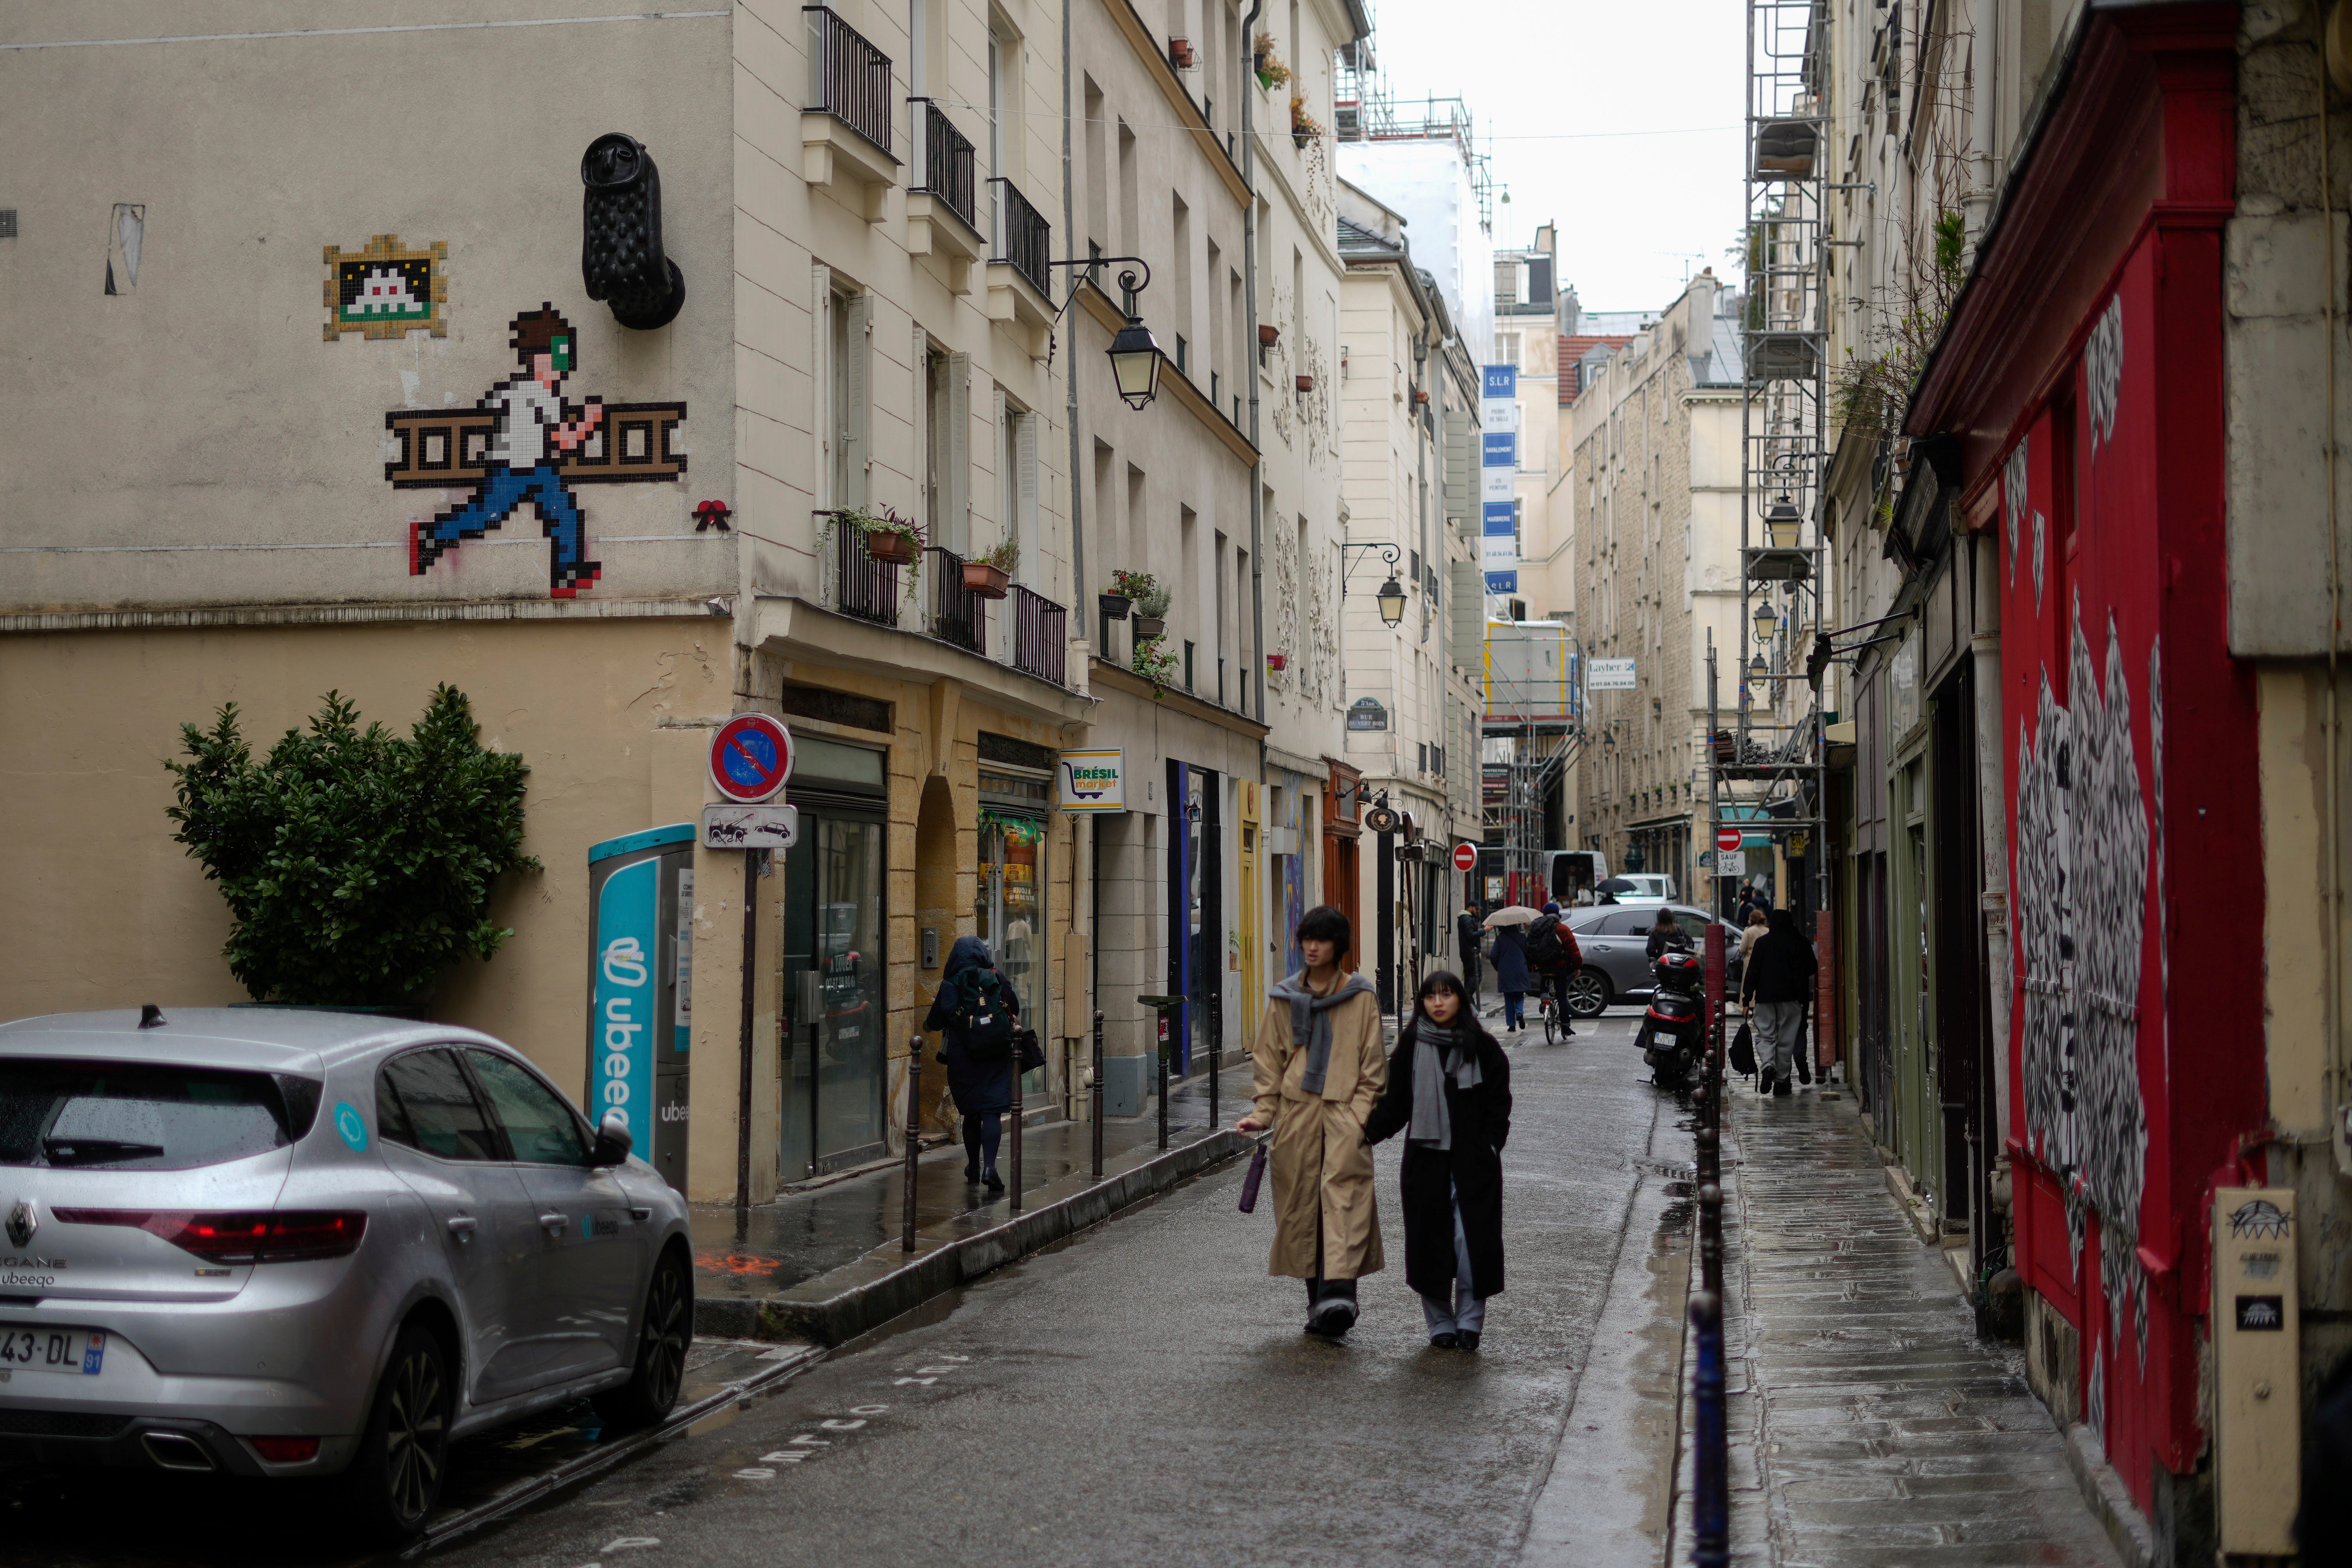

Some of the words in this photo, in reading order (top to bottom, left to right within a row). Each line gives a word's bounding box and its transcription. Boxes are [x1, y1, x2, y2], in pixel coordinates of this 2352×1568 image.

[1490, 376, 1509, 386] S.L.R
[1590, 662, 1621, 673] Layher
[1074, 766, 1118, 779] BRÉSIL
[1076, 778, 1116, 788] market
[830, 958, 834, 973] A
[836, 956, 853, 972] LOUER
[845, 975, 851, 988] 80
[596, 997, 642, 1134] ubeeq
[662, 1100, 690, 1121] ubee
[592, 1216, 618, 1239] ubeeqo
[0, 1256, 66, 1269] GANE
[2, 1272, 54, 1288] ubeeqo
[0, 1332, 78, 1366] 43-DL
[85, 1354, 100, 1368] 91
